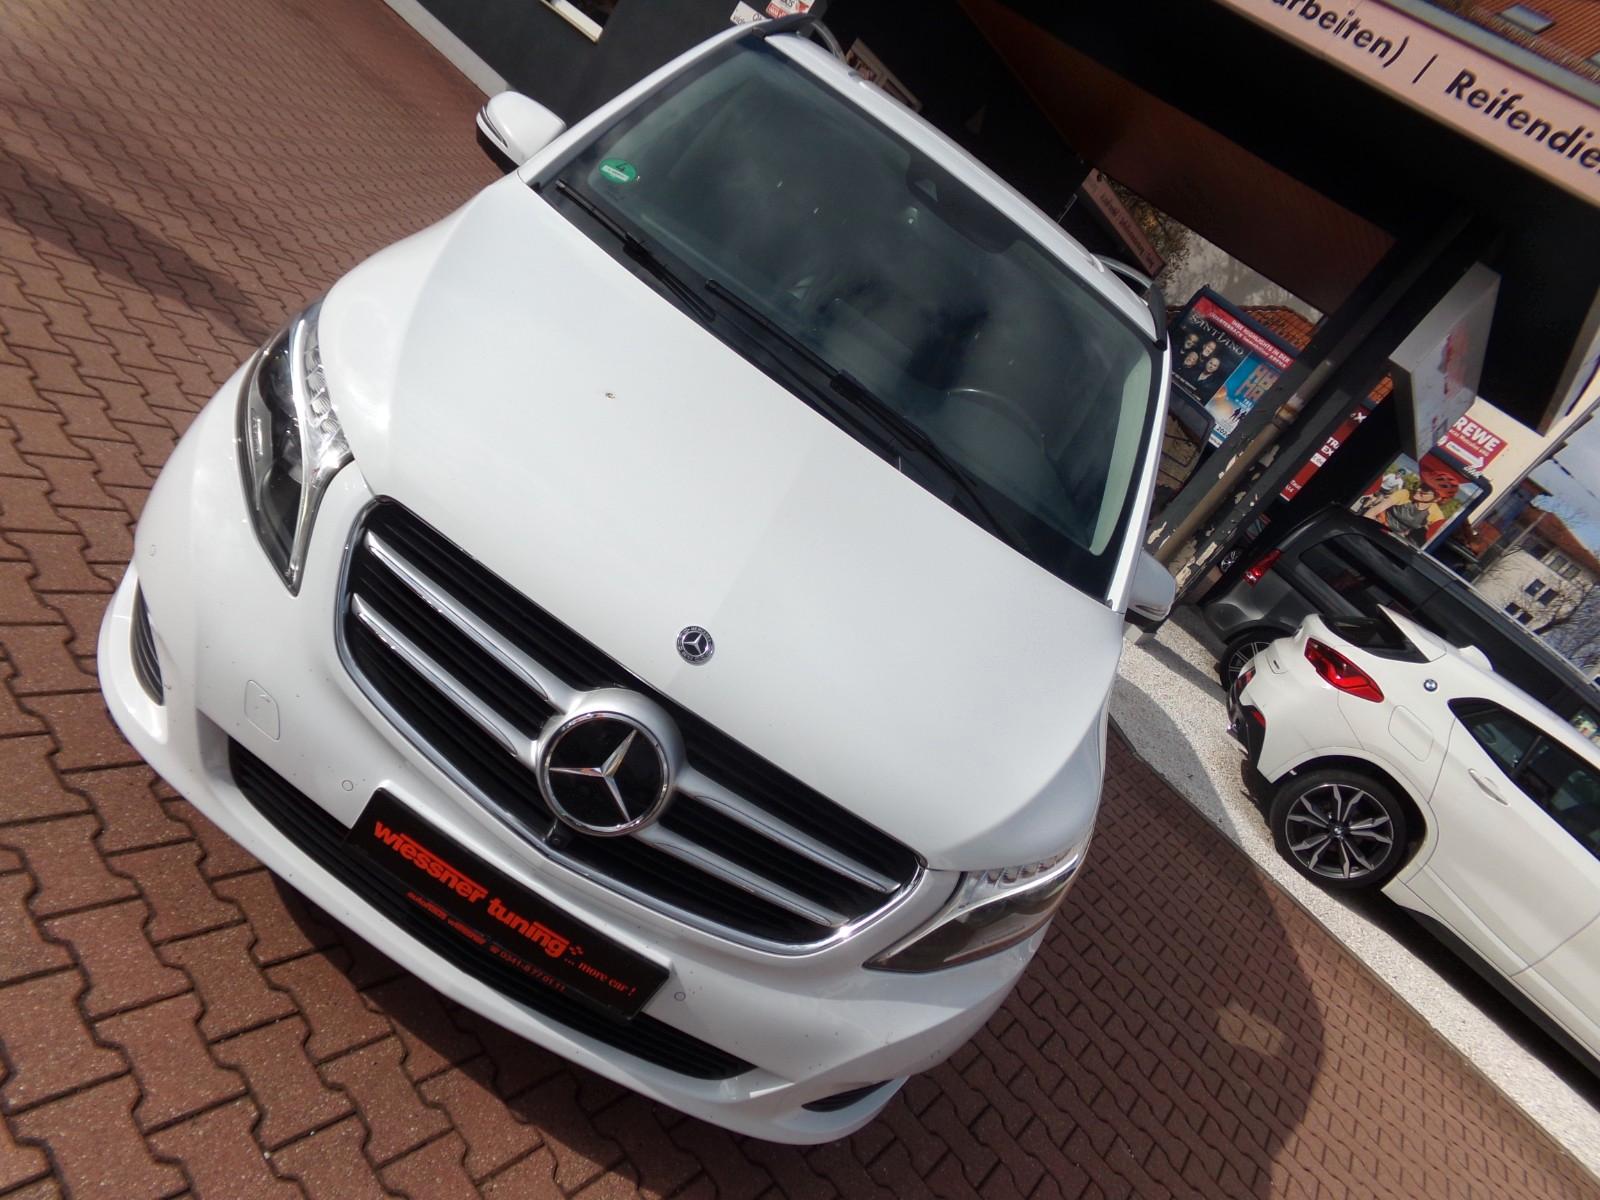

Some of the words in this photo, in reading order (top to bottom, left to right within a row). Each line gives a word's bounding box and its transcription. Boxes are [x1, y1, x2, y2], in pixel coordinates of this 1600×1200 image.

[1445, 68, 1600, 173] Reifendie
[1190, 311, 1245, 357] SANTIANO
[1452, 416, 1500, 452] REWE
[374, 821, 489, 903] wiessner
[487, 898, 573, 958] tuning
[577, 961, 609, 983] more
[608, 977, 629, 993] car
